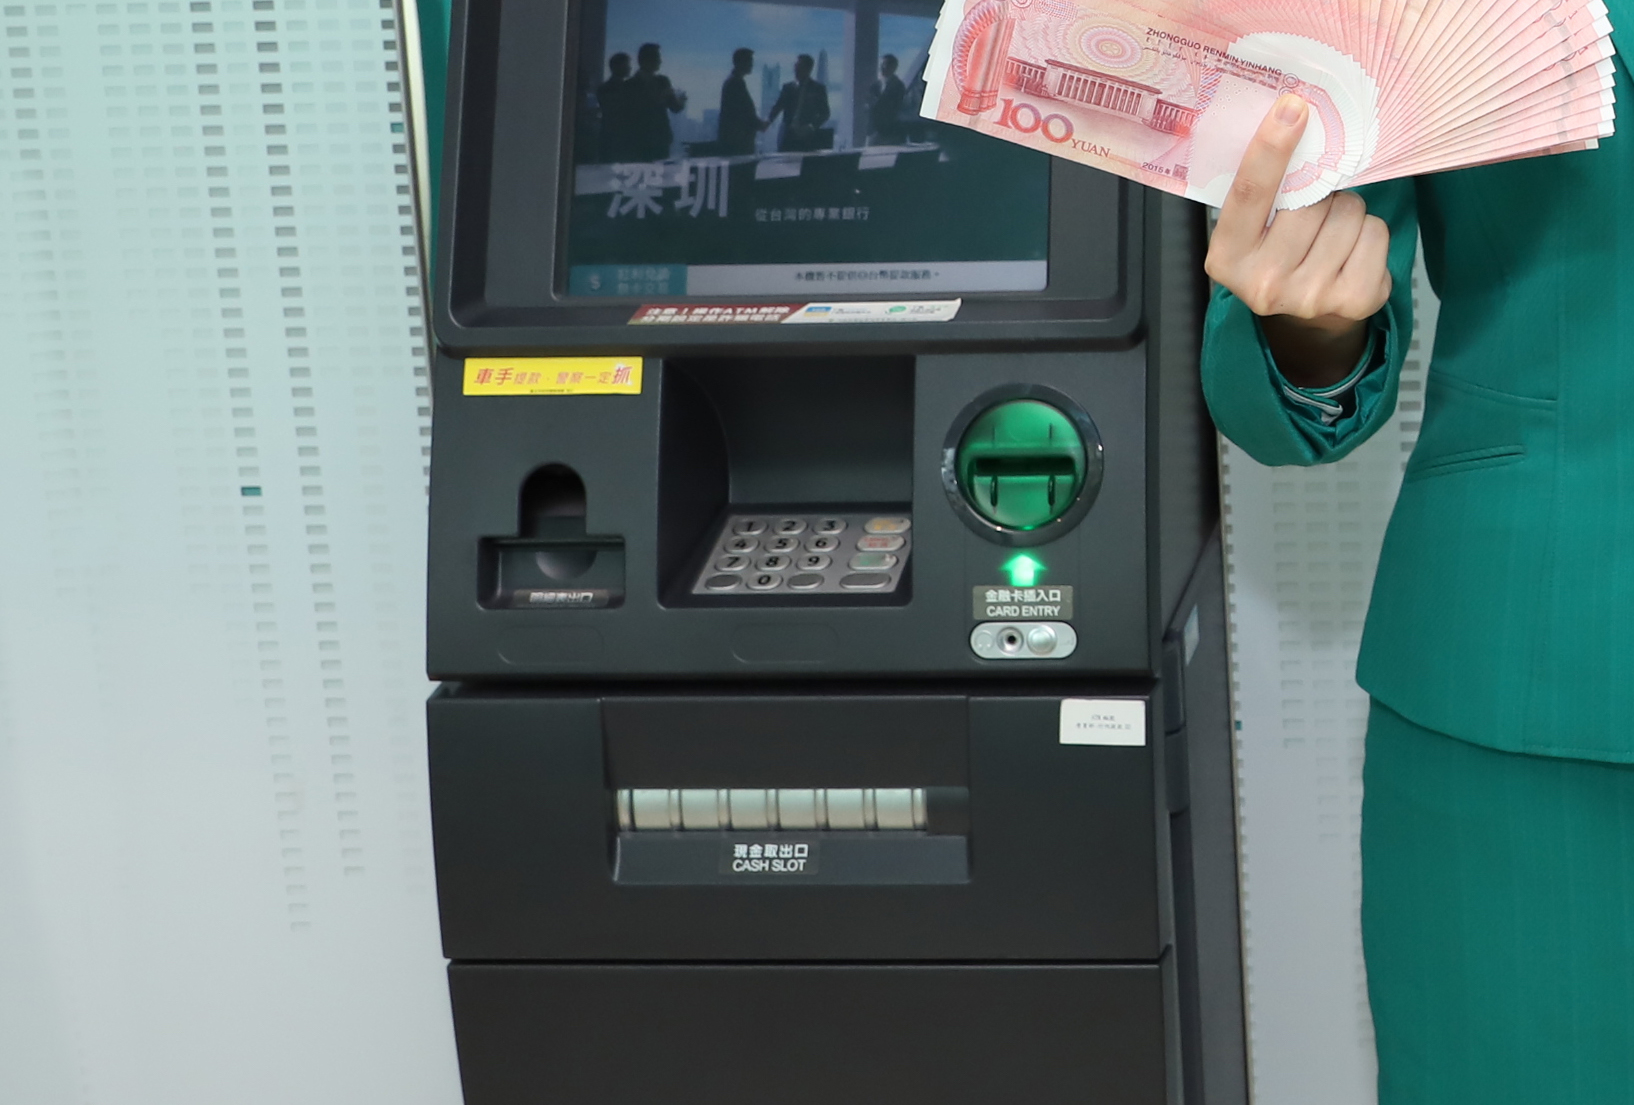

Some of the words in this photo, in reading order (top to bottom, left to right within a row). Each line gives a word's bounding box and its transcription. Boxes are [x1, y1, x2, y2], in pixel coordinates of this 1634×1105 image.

[1146, 27, 1201, 50] ZHONGGUO
[1202, 45, 1239, 65] RENMIN
[1240, 58, 1283, 77] YINHANG
[996, 97, 1075, 144] 100
[1071, 137, 1112, 159] YUAN
[606, 161, 729, 219] 深圳
[985, 588, 1062, 603] 金融卡插入口
[986, 605, 1020, 617] CARD
[1021, 605, 1061, 617] ENTRY
[733, 843, 809, 858] 現金取出口
[733, 859, 768, 873] CASH
[771, 857, 807, 871] SLOT
